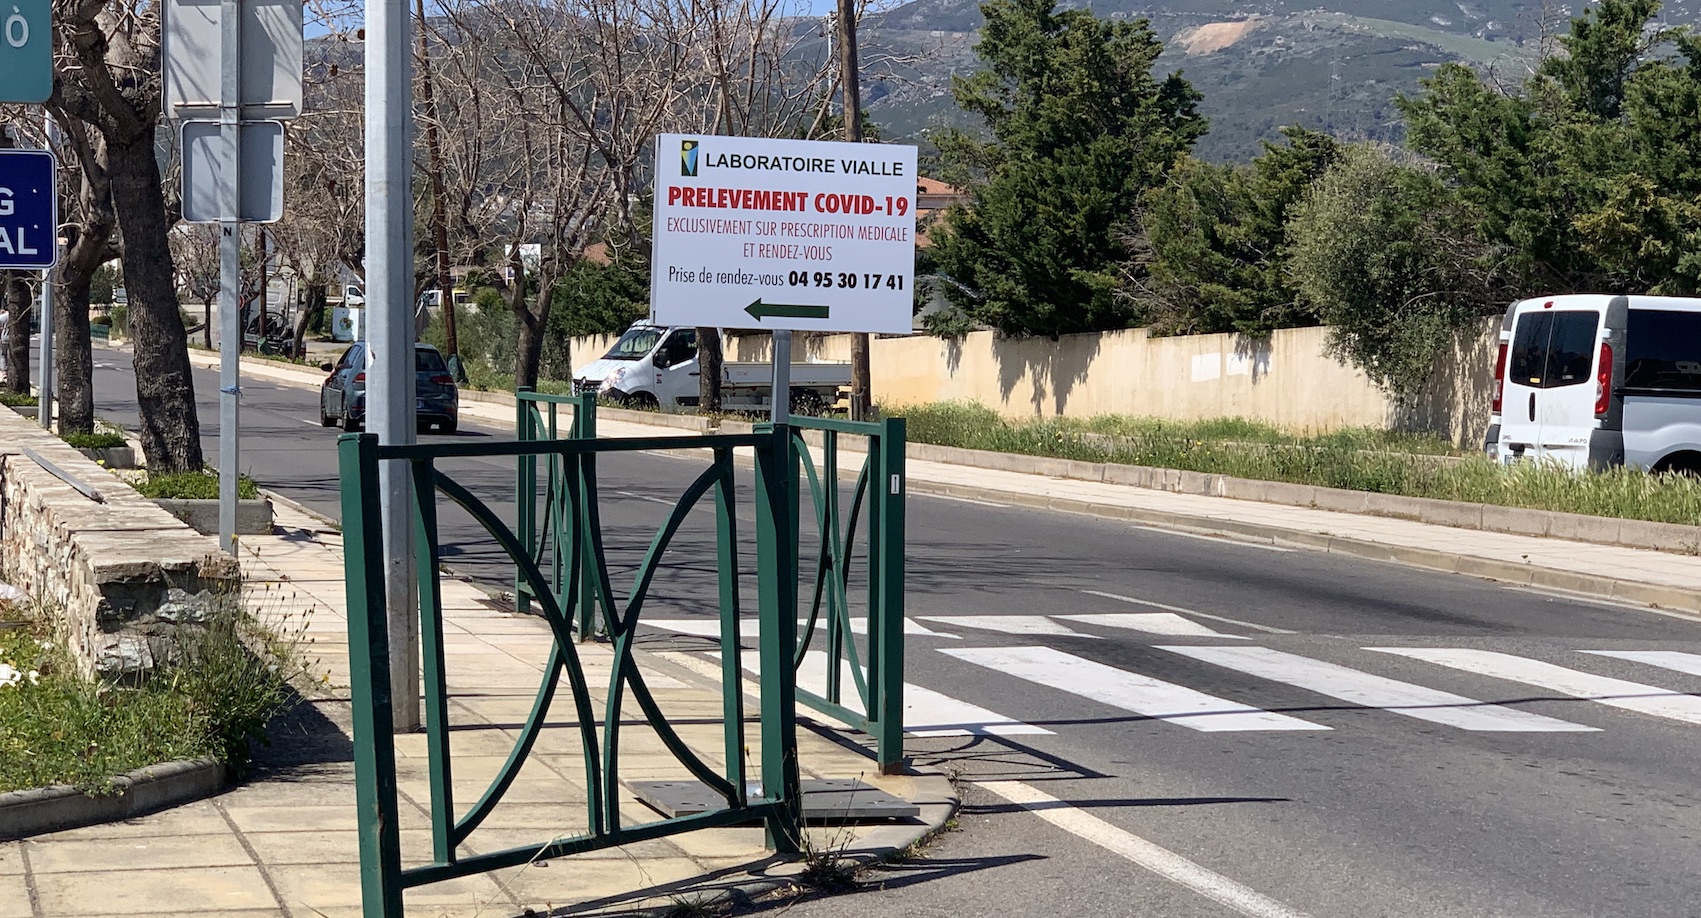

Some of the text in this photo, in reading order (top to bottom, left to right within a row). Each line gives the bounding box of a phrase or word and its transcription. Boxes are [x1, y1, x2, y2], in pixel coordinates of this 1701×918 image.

[705, 152, 903, 177] LABORATOIRE VIALLE
[668, 186, 909, 217] PRELEVEMENT COVID-19
[223, 227, 232, 236] N
[667, 217, 908, 242] EXCLUSIVEMENT SUR PRESCRIPTION MEDICALE
[743, 242, 833, 261] ET RENDEZ-VOUS
[669, 265, 904, 291] Prise de rendez-vous 04 95 30 17 41
